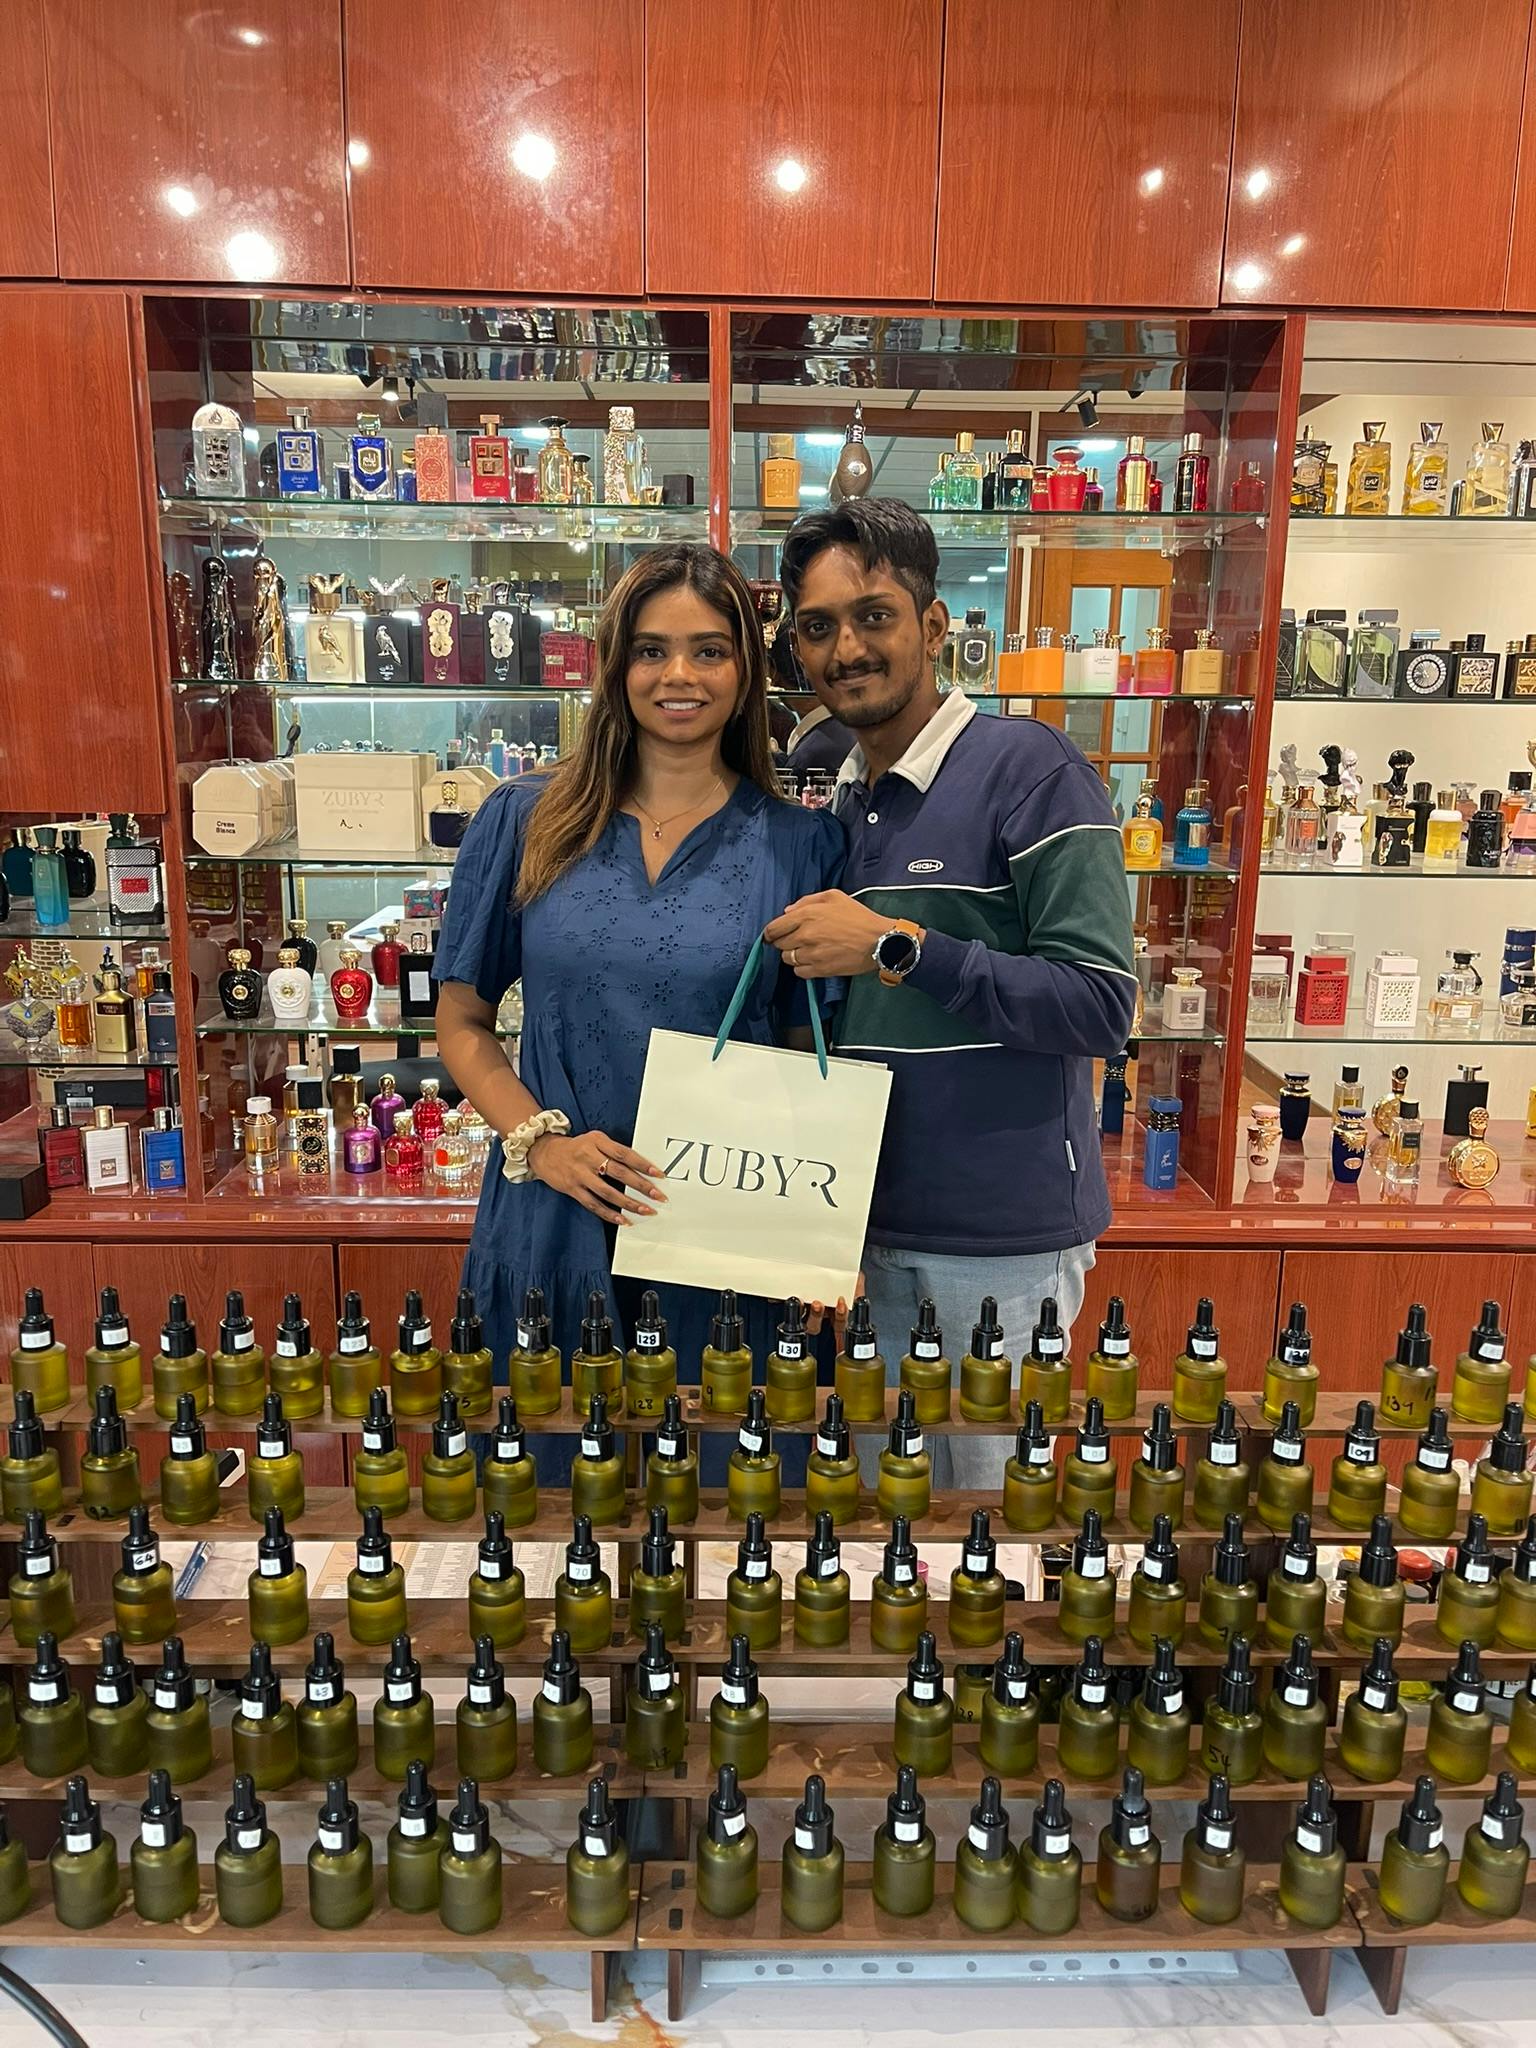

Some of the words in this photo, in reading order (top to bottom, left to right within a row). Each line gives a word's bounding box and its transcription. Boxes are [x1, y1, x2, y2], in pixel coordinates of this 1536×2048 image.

[663, 1137, 838, 1208] ZUBYR
[639, 1335, 656, 1345] 128
[781, 1345, 798, 1354] 130
[633, 1399, 653, 1410] 128
[1350, 1443, 1370, 1460] 109
[1209, 1745, 1231, 1773] 54
